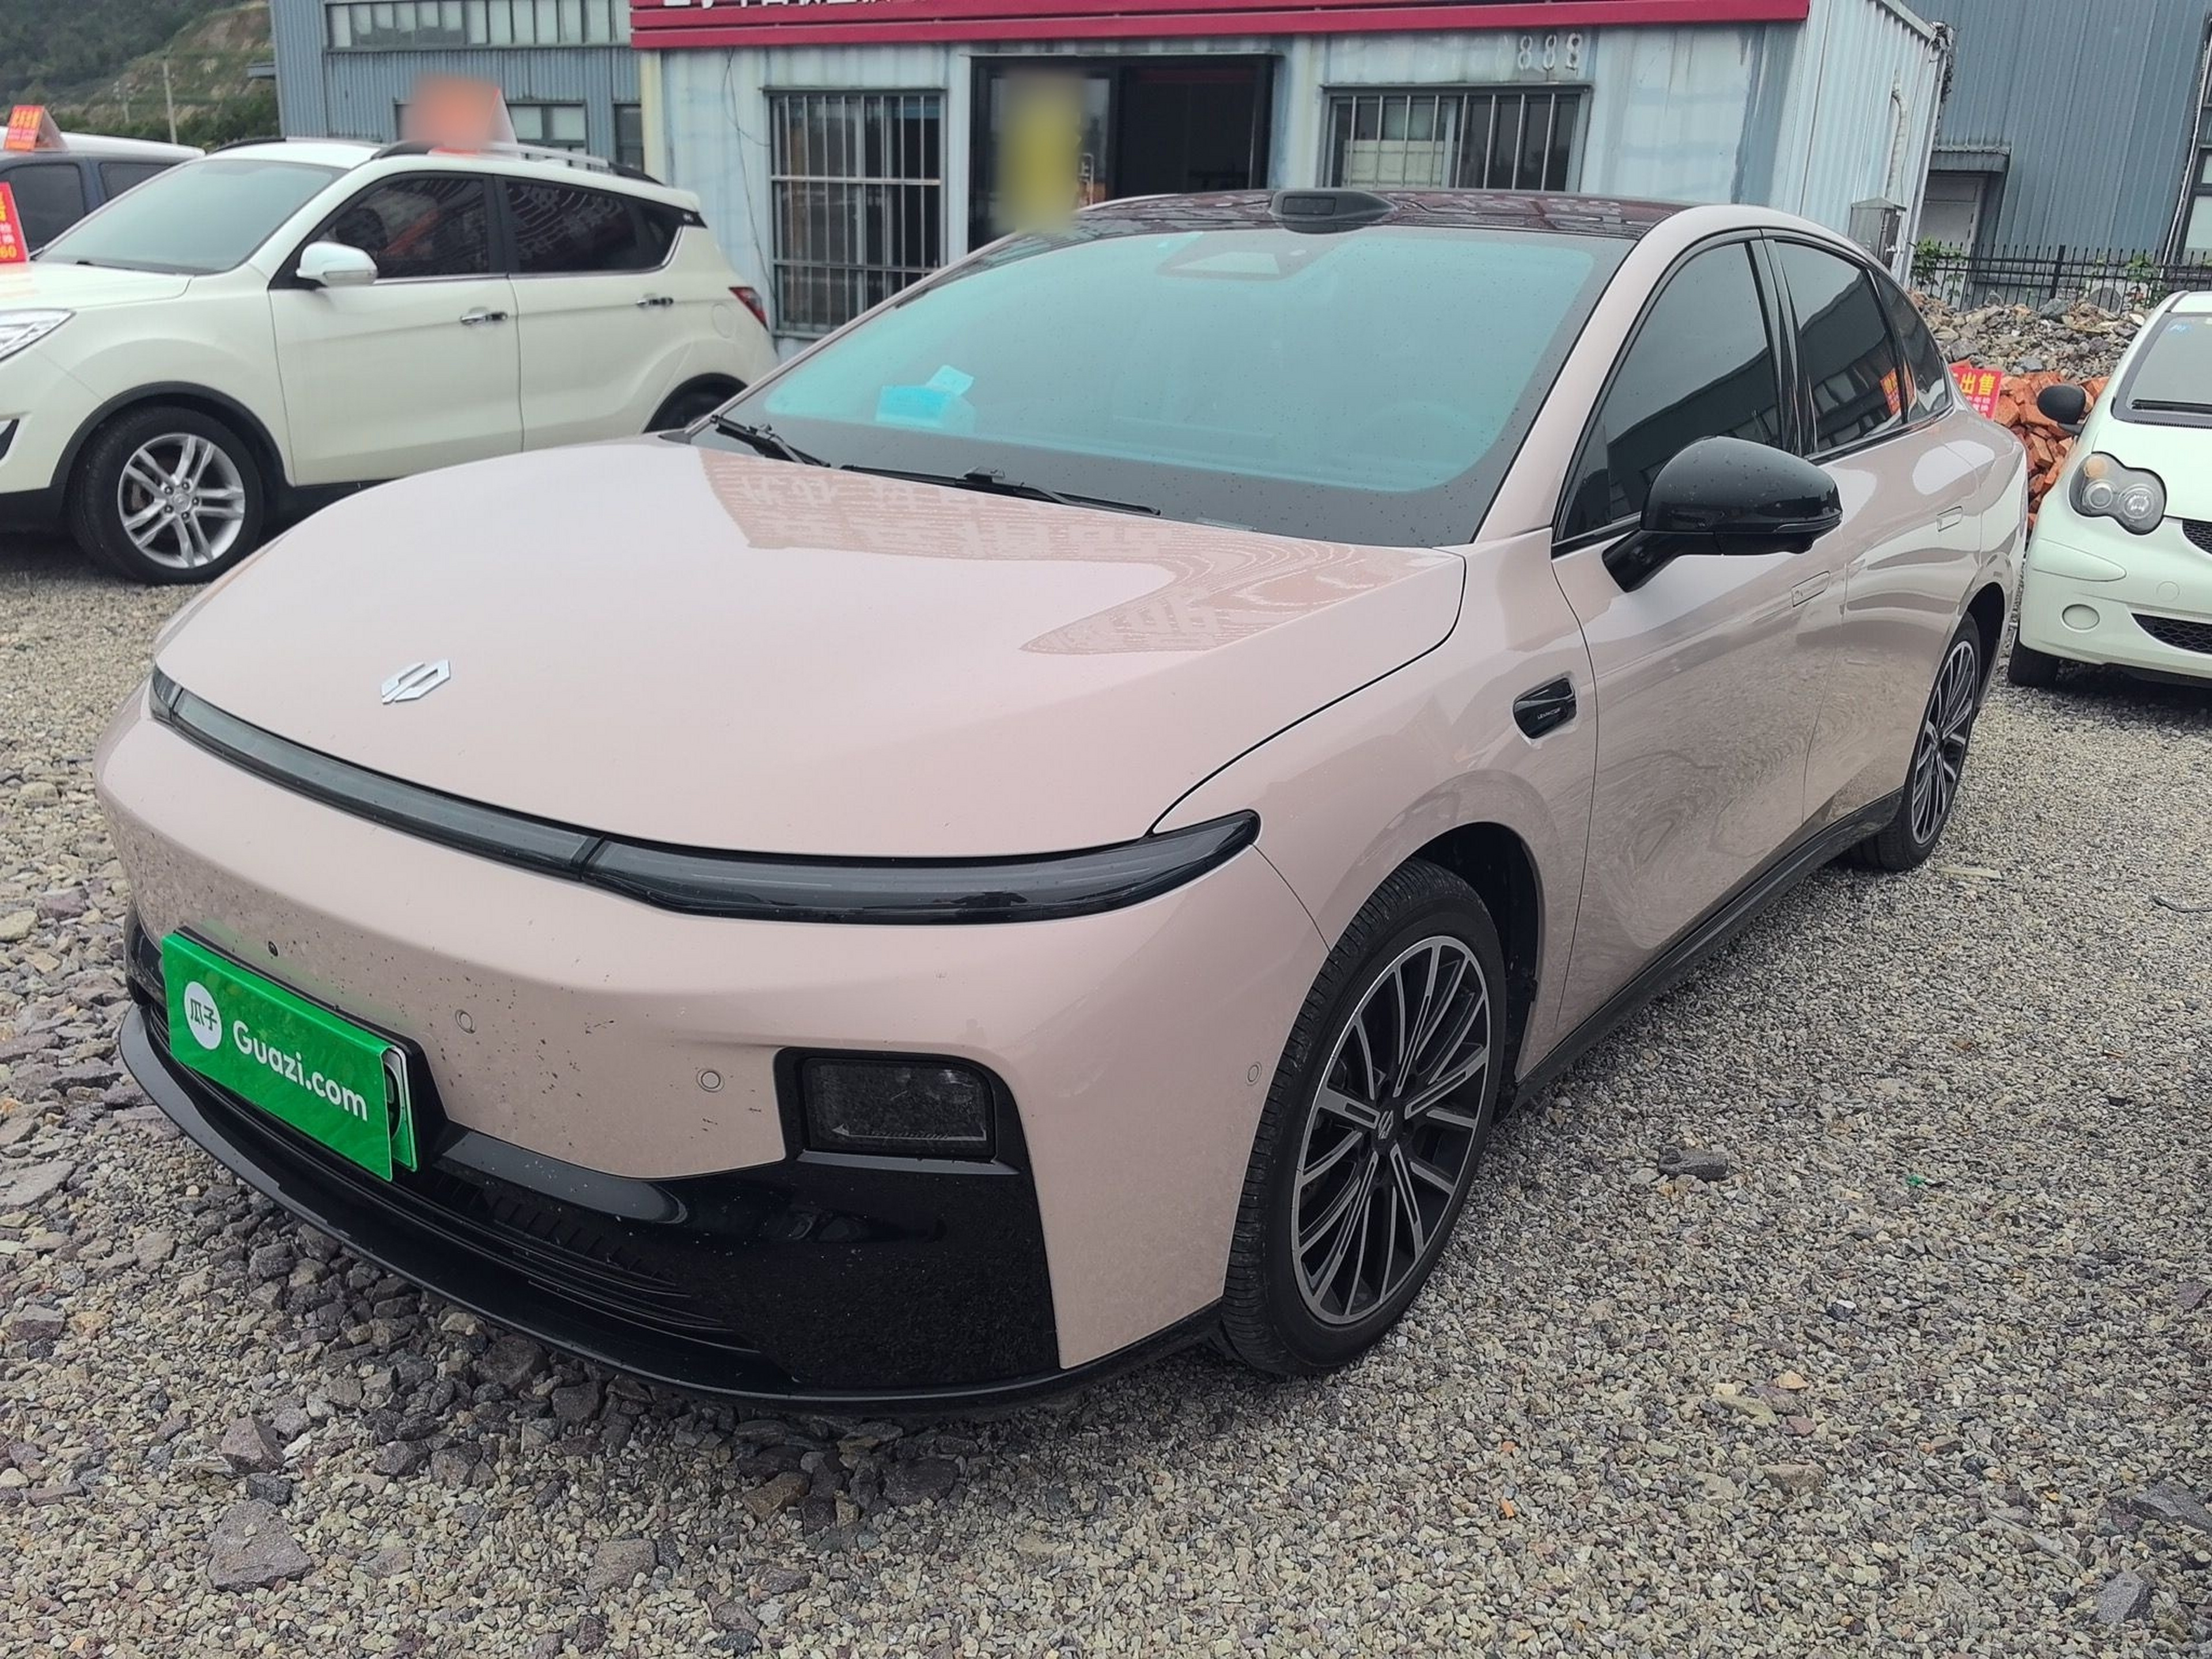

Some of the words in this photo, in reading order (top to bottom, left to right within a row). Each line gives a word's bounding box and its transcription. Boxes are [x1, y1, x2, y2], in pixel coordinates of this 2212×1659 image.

[1953, 371, 1996, 396] 出售
[190, 998, 218, 1032] 瓜子
[233, 1020, 368, 1122] Guazi.com
